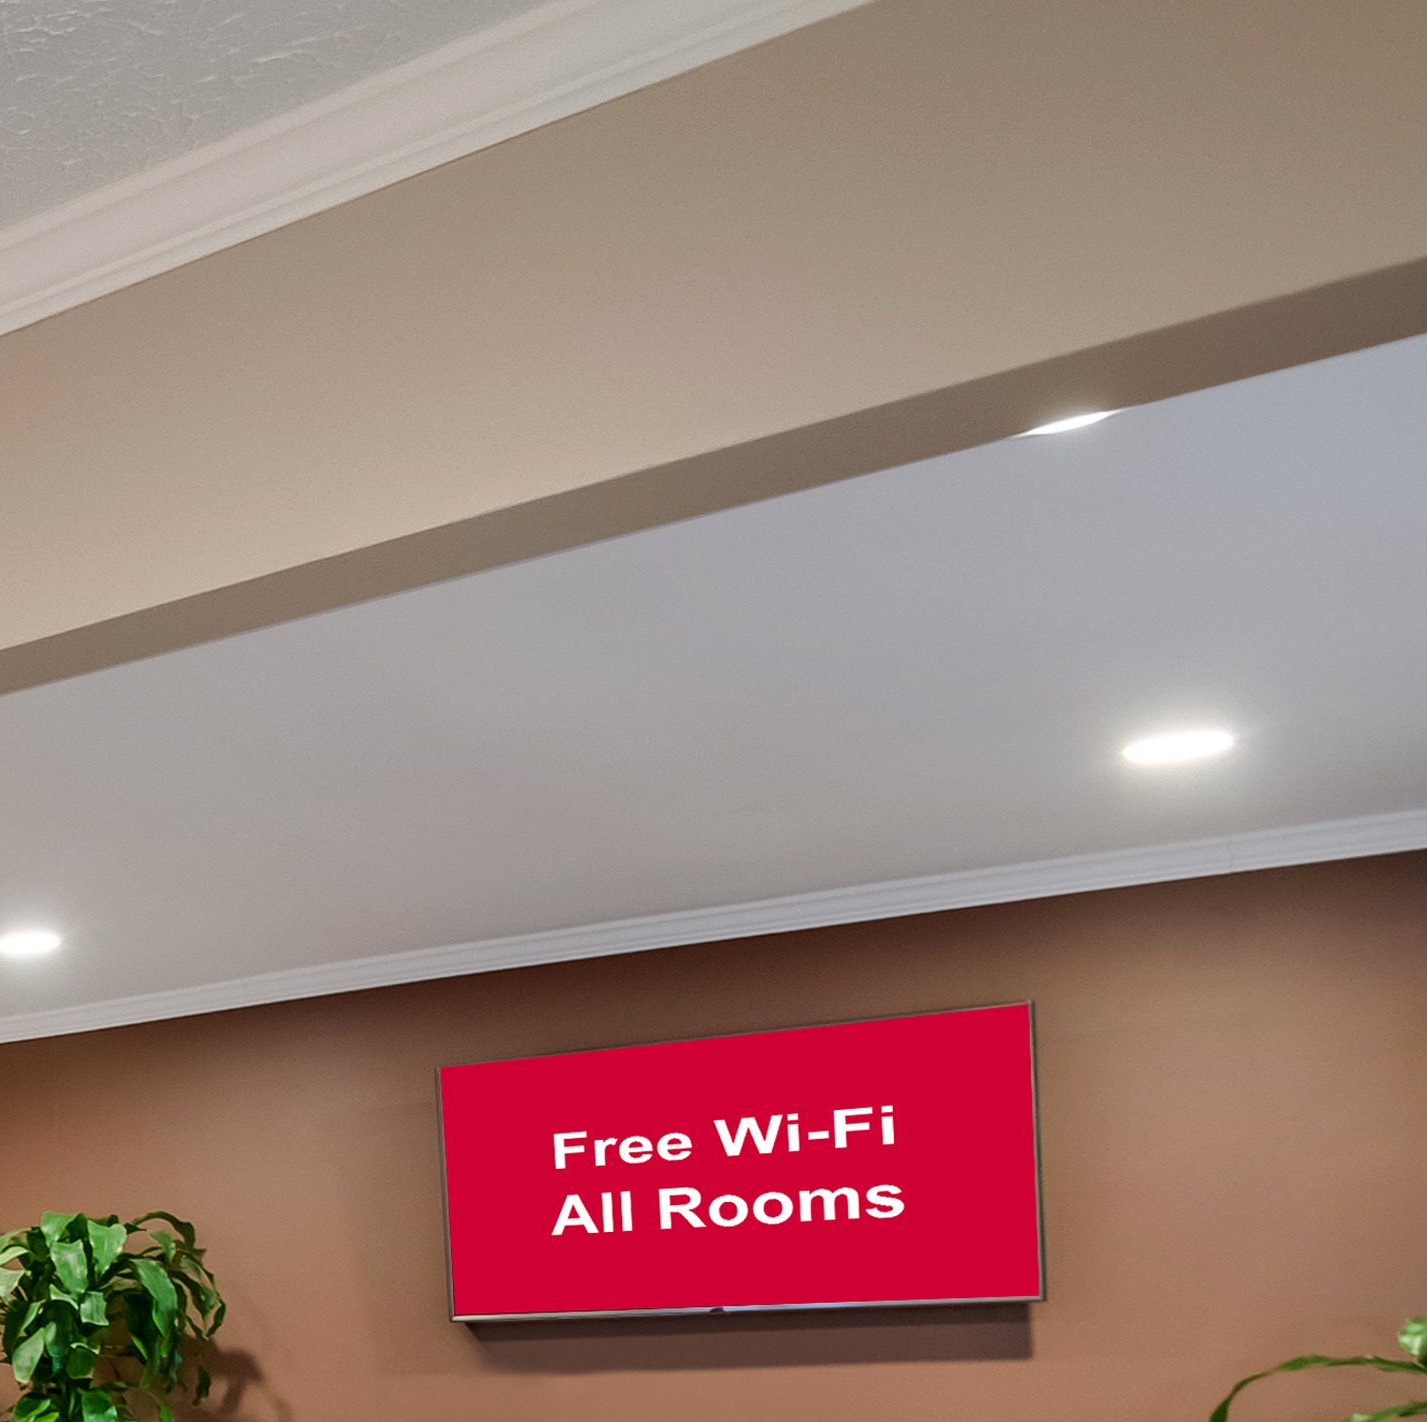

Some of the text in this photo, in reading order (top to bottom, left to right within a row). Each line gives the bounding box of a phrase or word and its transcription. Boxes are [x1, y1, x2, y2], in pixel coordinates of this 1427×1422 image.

[553, 1106, 896, 1170] Free Wi-Fi
[551, 1185, 906, 1236] All Rooms
